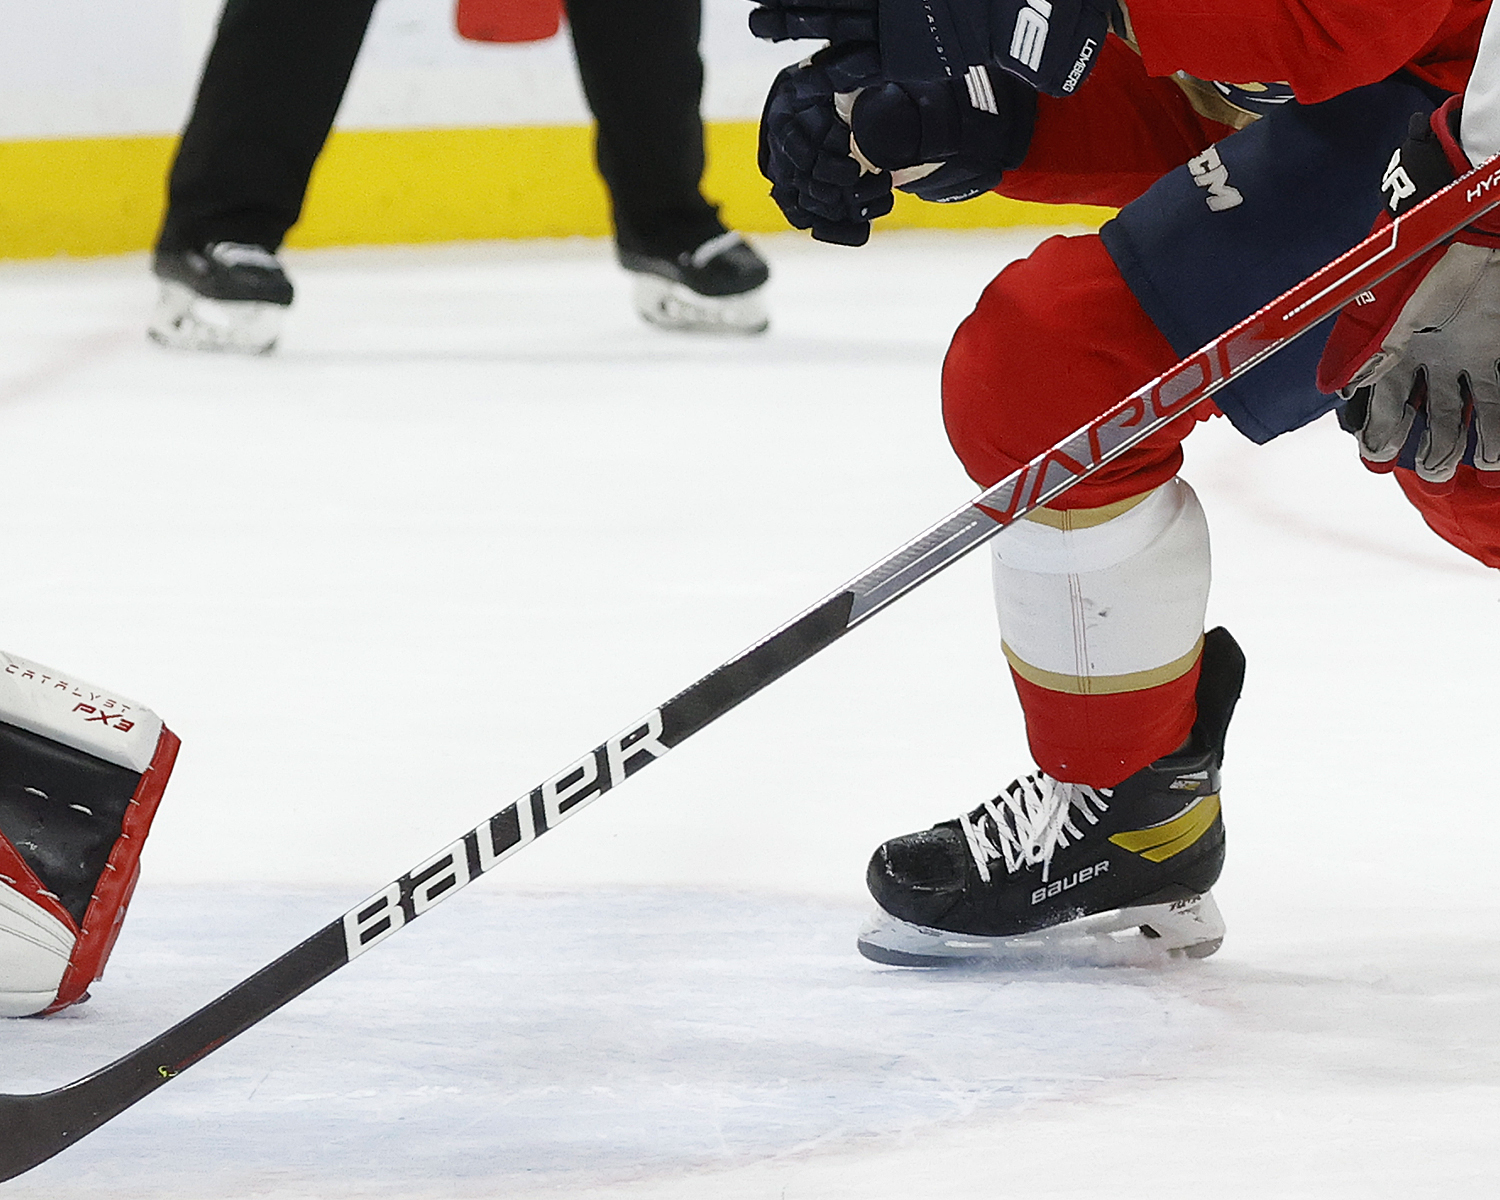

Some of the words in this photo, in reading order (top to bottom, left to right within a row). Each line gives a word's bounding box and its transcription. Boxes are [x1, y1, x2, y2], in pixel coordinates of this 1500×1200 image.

[1062, 36, 1098, 94] LOMBERG
[1187, 142, 1244, 213] CM
[973, 320, 1274, 527] VAPOR
[5, 663, 131, 713] CATALYST
[71, 702, 136, 733] PX3
